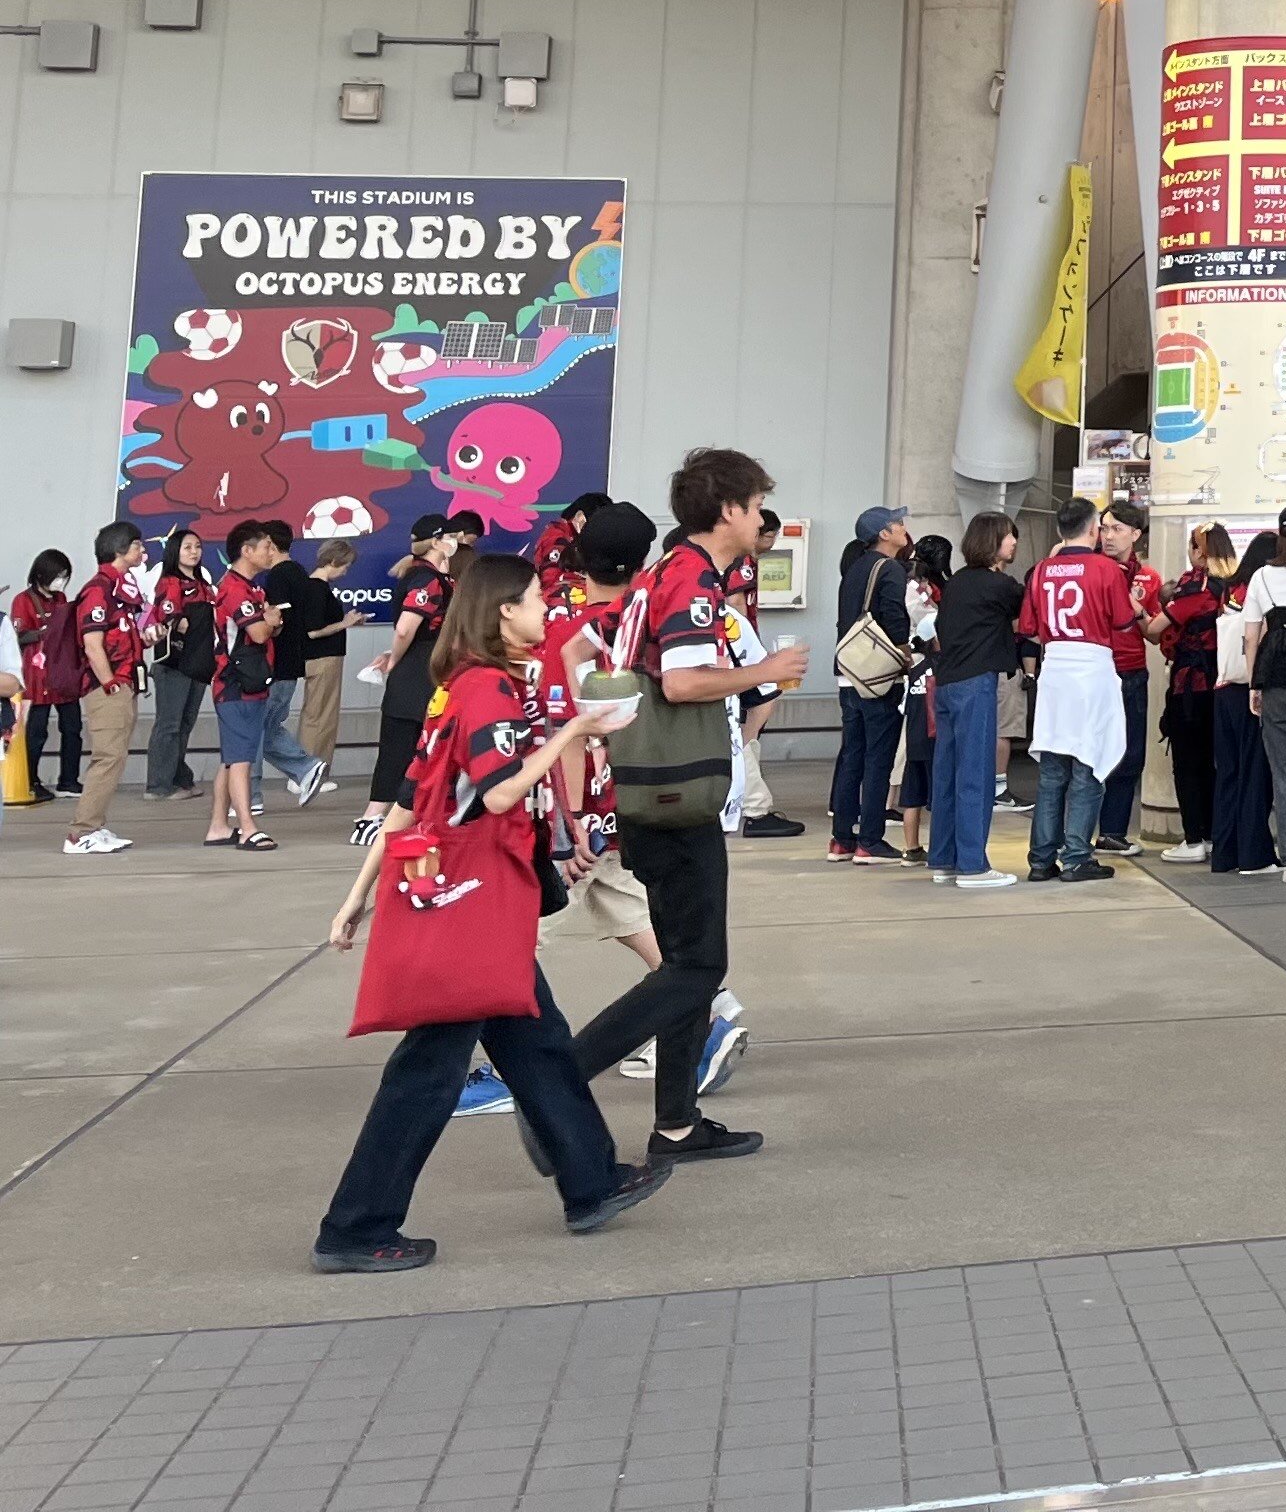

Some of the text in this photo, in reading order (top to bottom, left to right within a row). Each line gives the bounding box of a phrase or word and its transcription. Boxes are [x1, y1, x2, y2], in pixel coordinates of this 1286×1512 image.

[311, 190, 474, 205] THIS STADIUM IS
[183, 213, 581, 260] POWERED BY
[1247, 248, 1266, 262] 4F
[235, 272, 526, 296] OCTOPUS ENERGY
[332, 586, 392, 607] topus
[1043, 581, 1085, 637] 12
